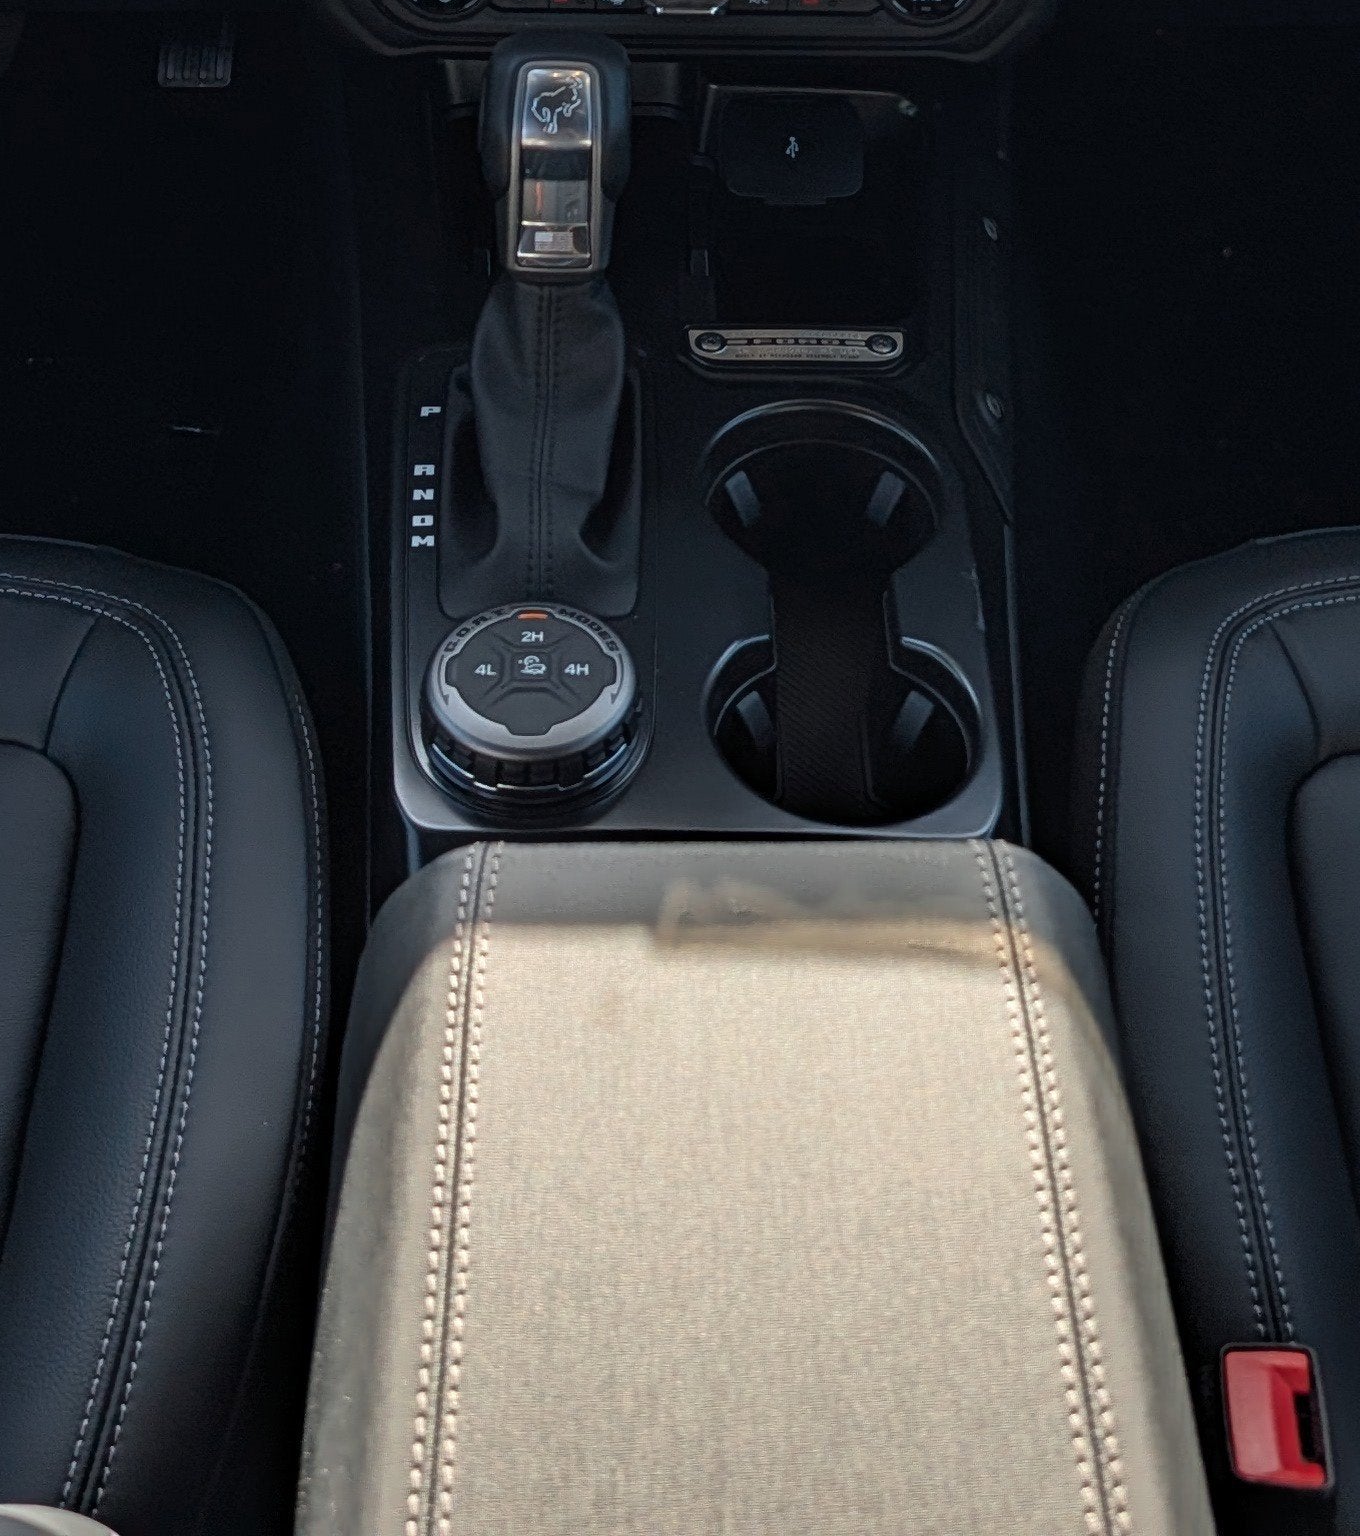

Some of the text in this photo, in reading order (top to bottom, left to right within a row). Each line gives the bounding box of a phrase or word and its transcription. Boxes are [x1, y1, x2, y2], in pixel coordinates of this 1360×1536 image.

[419, 406, 441, 417] P
[413, 464, 436, 476] R
[412, 489, 434, 501] N
[411, 515, 434, 527] D
[411, 536, 435, 548] M
[521, 631, 544, 642] 2H
[474, 664, 589, 676] 4L 4H
